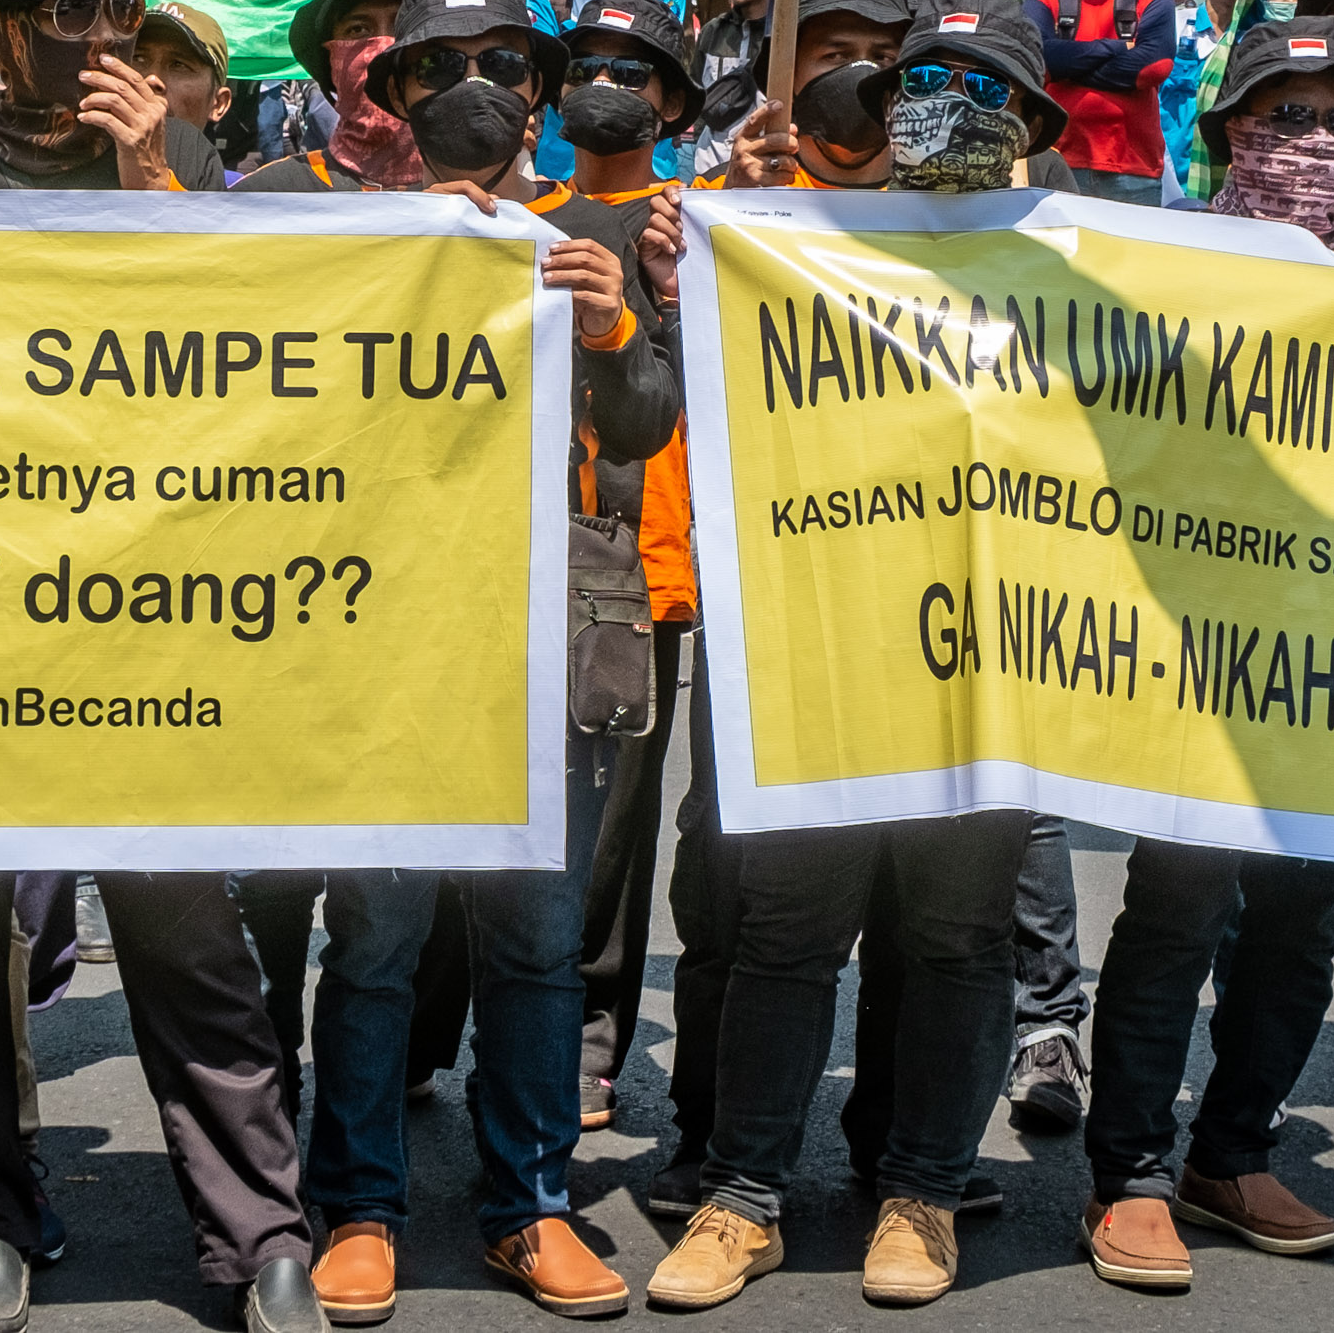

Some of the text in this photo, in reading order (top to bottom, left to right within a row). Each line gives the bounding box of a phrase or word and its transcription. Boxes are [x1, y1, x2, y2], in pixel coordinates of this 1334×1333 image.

[25, 328, 318, 398] SAMPE
[343, 331, 507, 401] TUA
[759, 293, 1049, 414] NAIKKAN
[1067, 298, 1190, 426] UMK
[155, 466, 345, 503] cuman
[771, 481, 925, 538] KASIAN
[937, 462, 1123, 536] JOMBLO
[1132, 504, 1164, 547] DI
[1173, 512, 1297, 571] PABRIK
[24, 554, 372, 643] doang??
[919, 577, 981, 681] GA
[999, 577, 1138, 701] NIKAH
